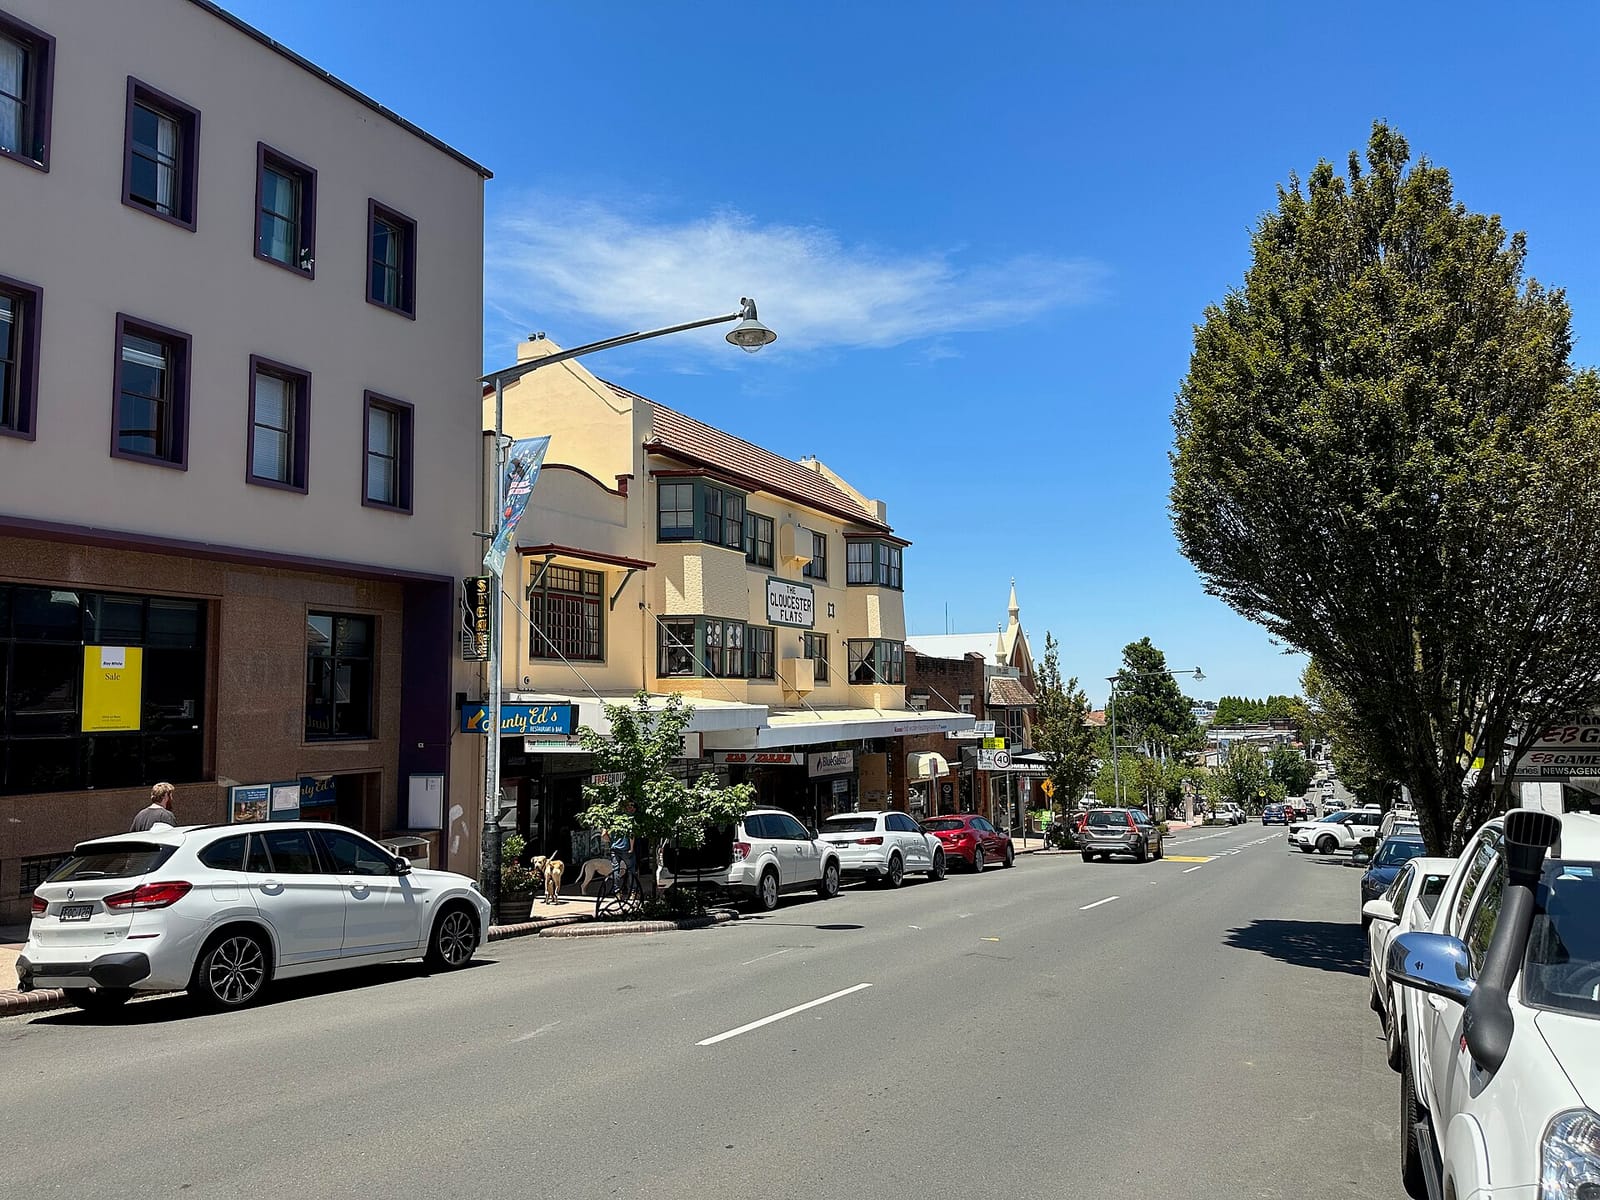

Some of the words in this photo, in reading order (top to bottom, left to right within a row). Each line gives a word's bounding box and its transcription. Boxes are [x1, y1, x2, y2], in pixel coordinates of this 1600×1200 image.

[786, 586, 796, 595] THE
[781, 609, 802, 623] FLATS
[104, 672, 120, 681] Sale
[529, 706, 557, 726] Ed's
[997, 755, 1009, 764] 40
[1542, 767, 1600, 775] NEWSAGEN
